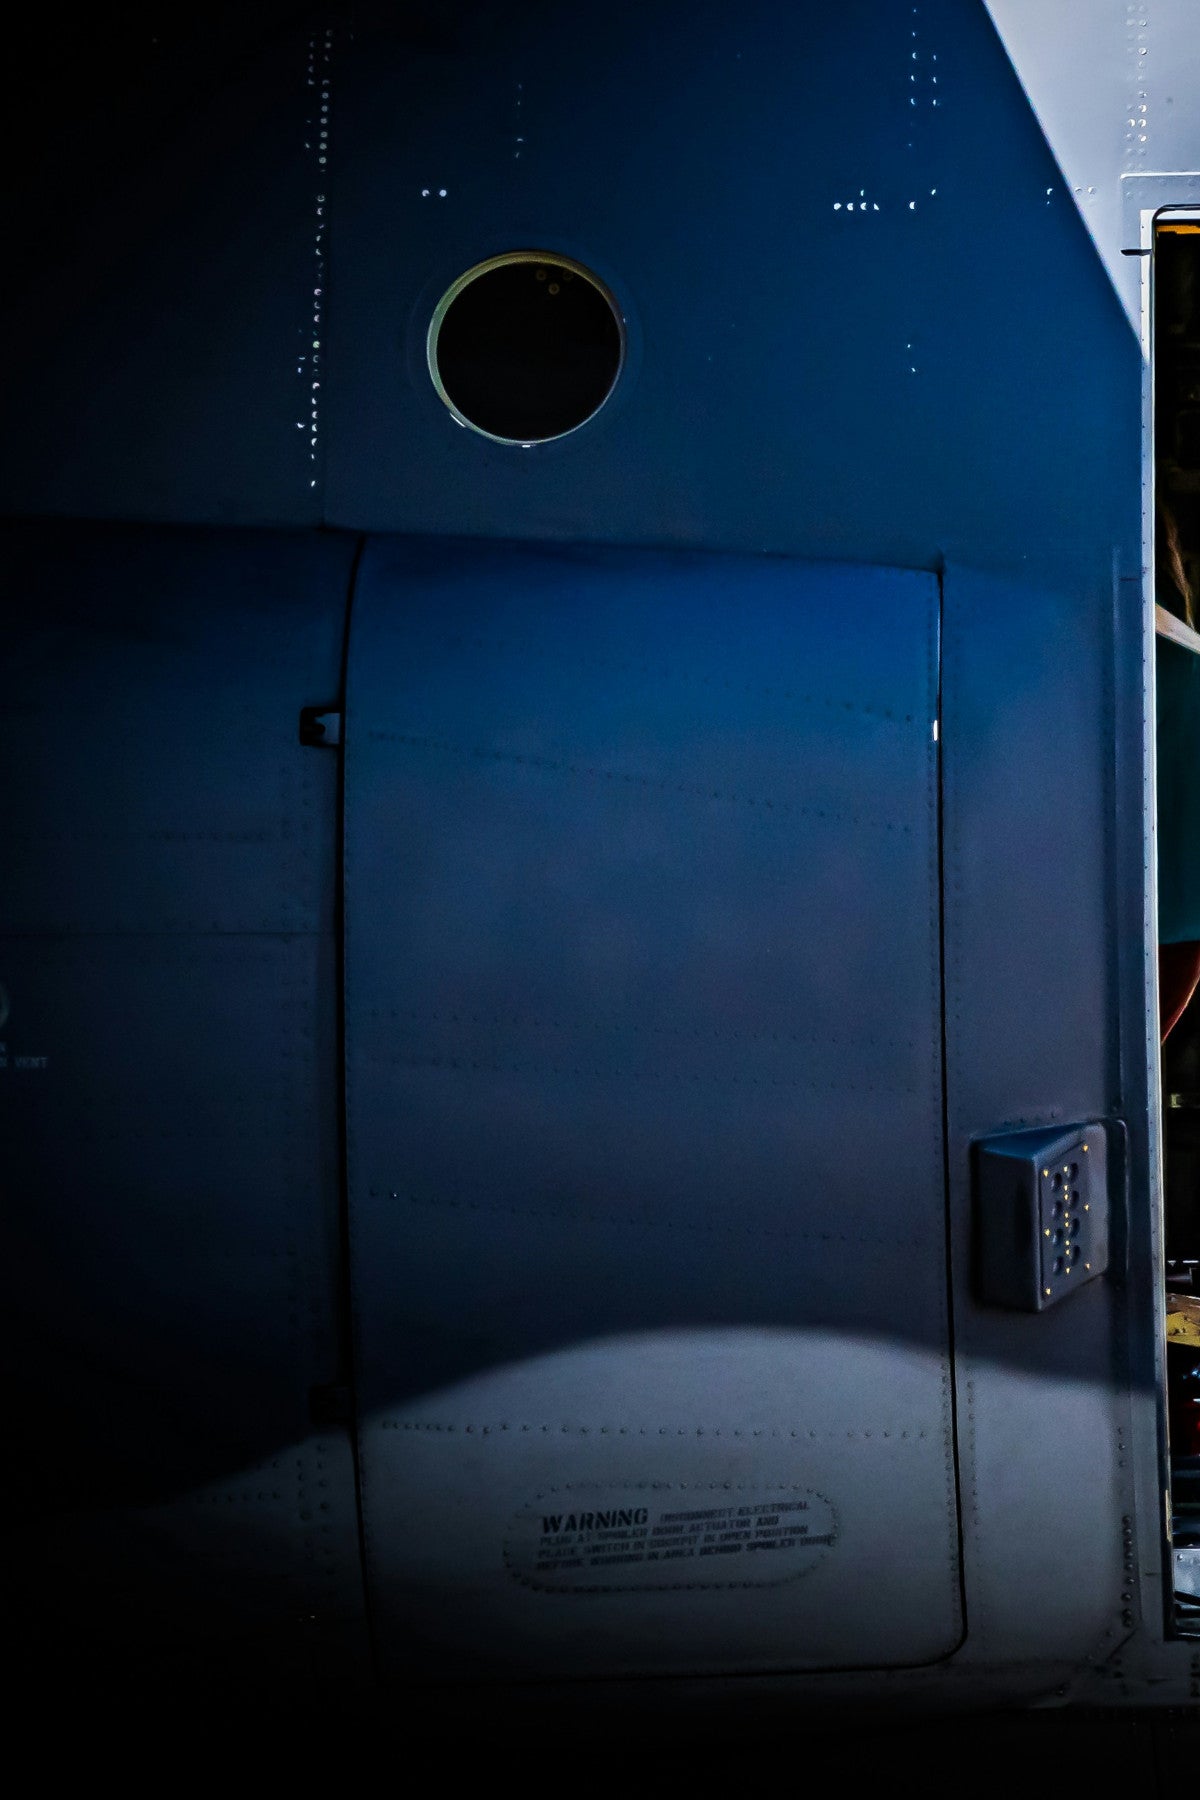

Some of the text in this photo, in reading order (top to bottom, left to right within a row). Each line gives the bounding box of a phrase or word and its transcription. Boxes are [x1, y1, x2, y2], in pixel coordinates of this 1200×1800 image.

[542, 1508, 649, 1534] WARNING
[737, 1500, 808, 1515] ELECTRICAL
[688, 1517, 751, 1531] ACTUATOR
[756, 1514, 779, 1527] AND
[584, 1542, 630, 1554] SWITCH
[720, 1530, 751, 1541] OPEN
